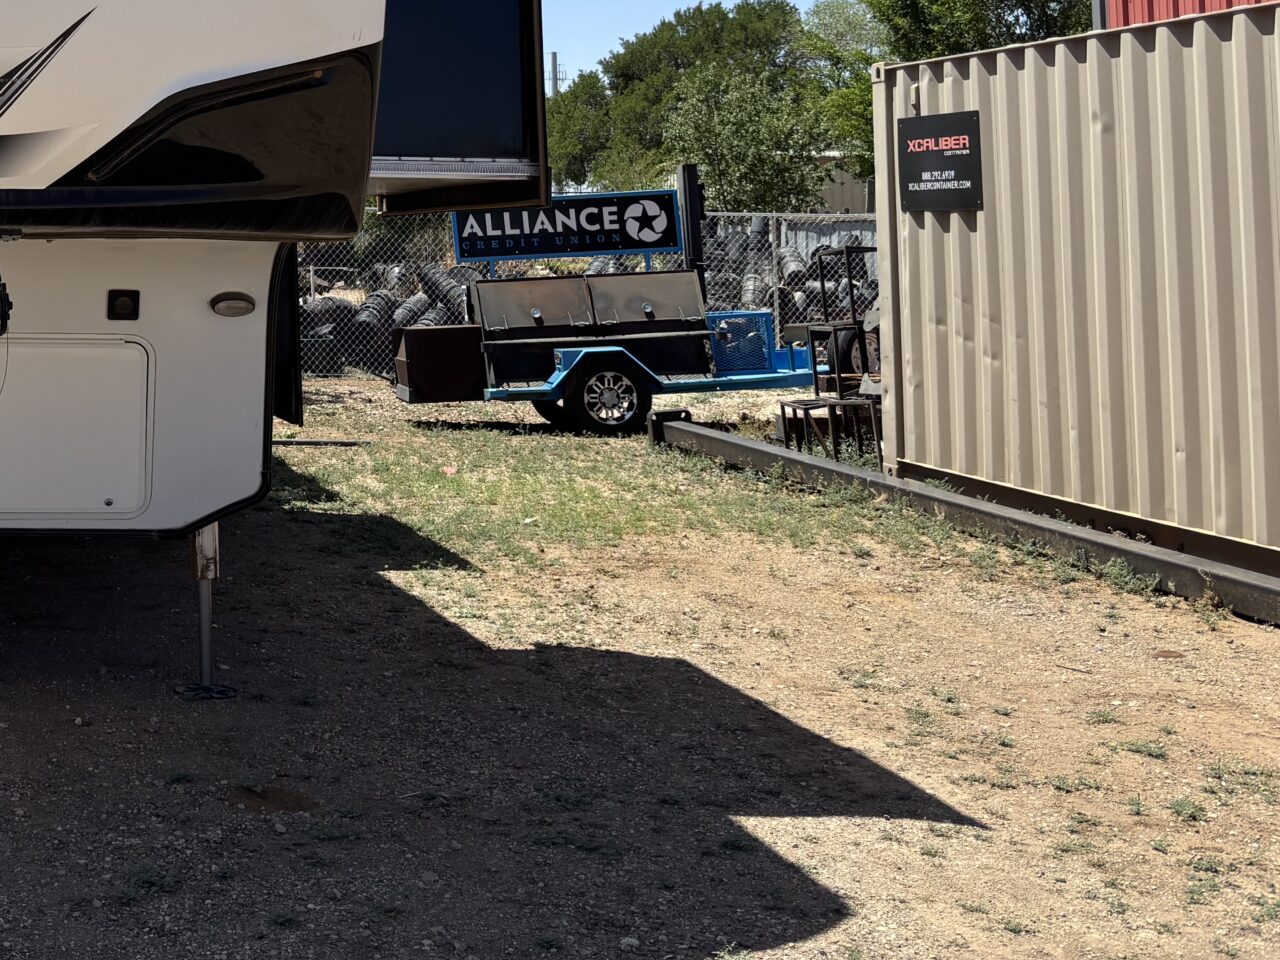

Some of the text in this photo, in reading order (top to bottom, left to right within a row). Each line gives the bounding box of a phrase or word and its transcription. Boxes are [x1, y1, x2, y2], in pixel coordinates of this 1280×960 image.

[907, 135, 969, 152] XCALIBER
[908, 180, 971, 191] XCALIBERCONTAINER.COM
[461, 205, 620, 237] ALLIANCE
[462, 232, 622, 250] CREDIT UNION
